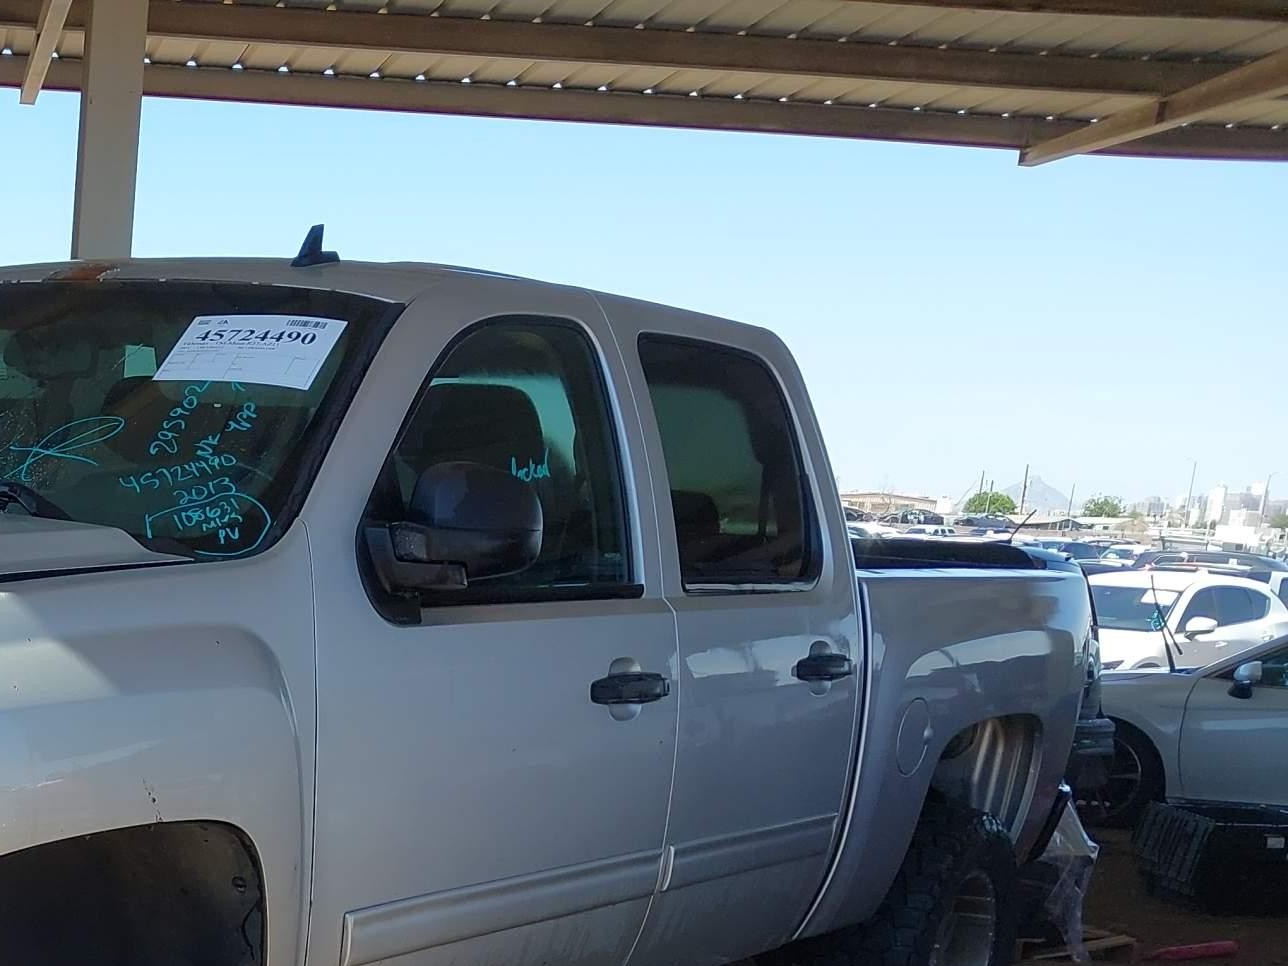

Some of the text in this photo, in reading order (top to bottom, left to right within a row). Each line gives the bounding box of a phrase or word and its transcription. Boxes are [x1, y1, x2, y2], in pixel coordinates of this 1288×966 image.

[196, 329, 317, 345] 45724490
[119, 454, 237, 493] 45724490
[173, 477, 236, 504] 2013
